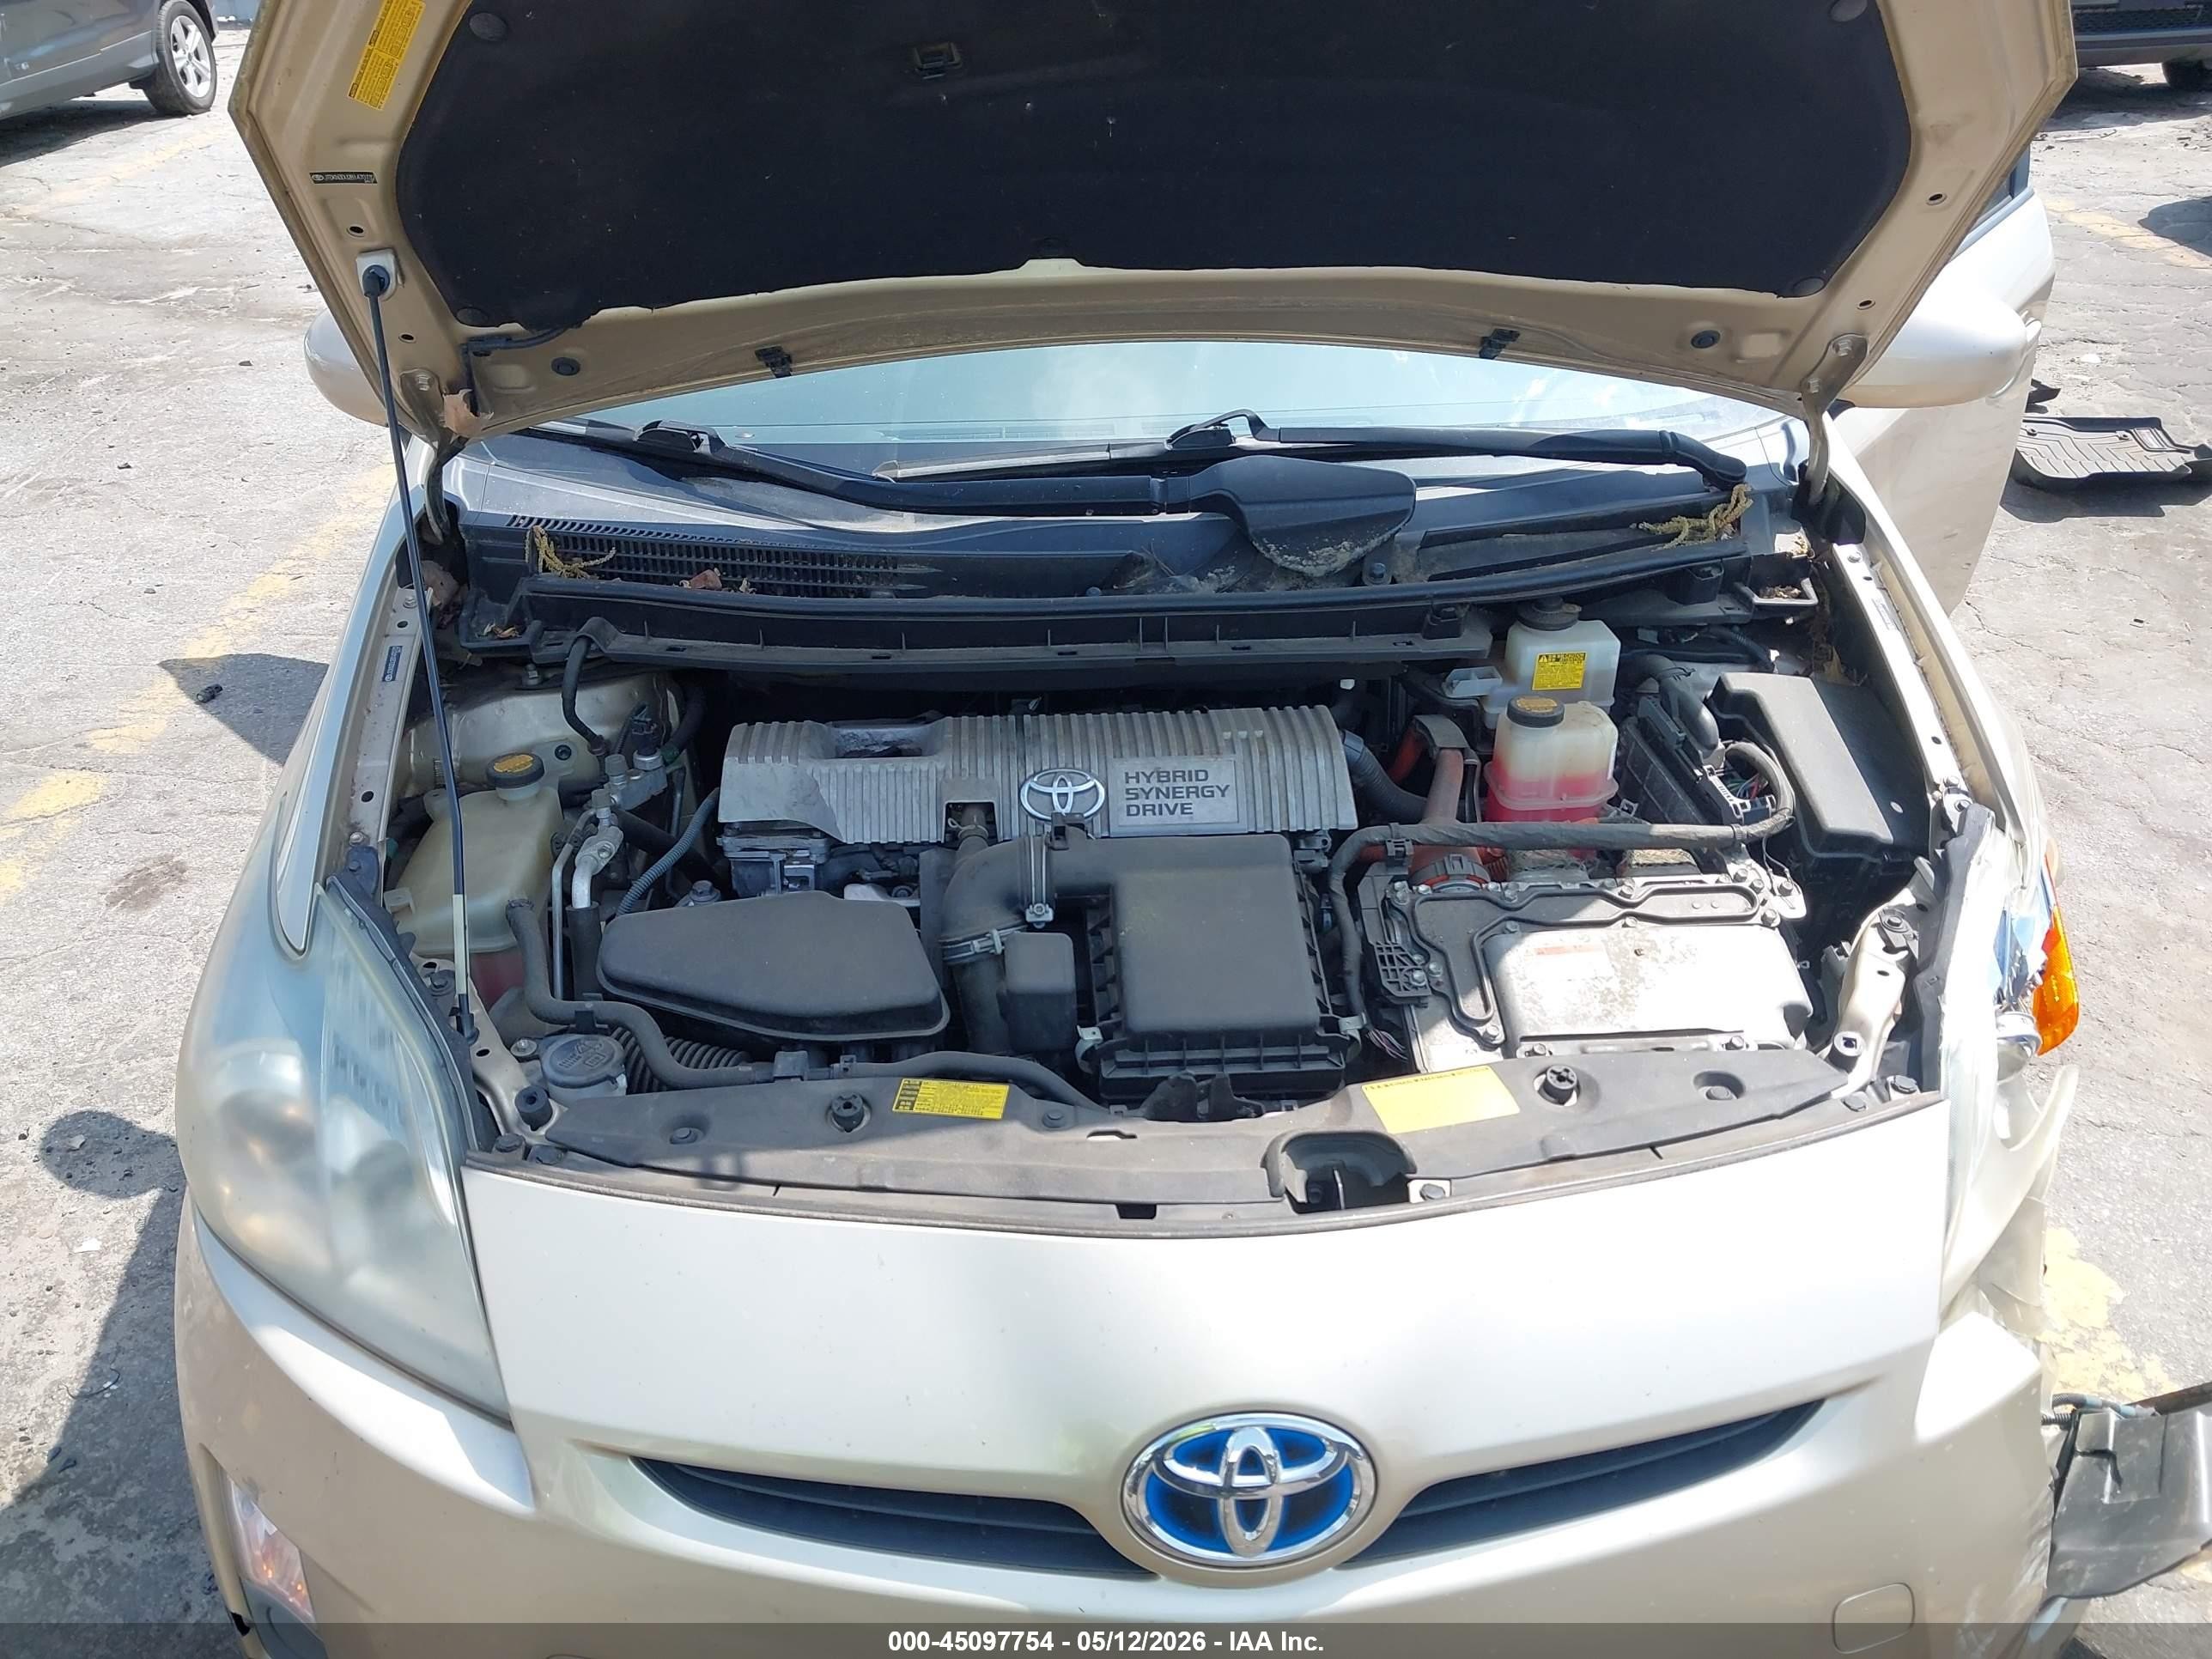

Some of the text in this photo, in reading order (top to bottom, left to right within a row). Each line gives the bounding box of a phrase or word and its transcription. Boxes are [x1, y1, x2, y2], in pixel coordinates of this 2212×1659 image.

[1124, 769, 1209, 784] HYBRID
[1125, 785, 1231, 800] SYNERGY
[1126, 802, 1194, 817] DRIVE
